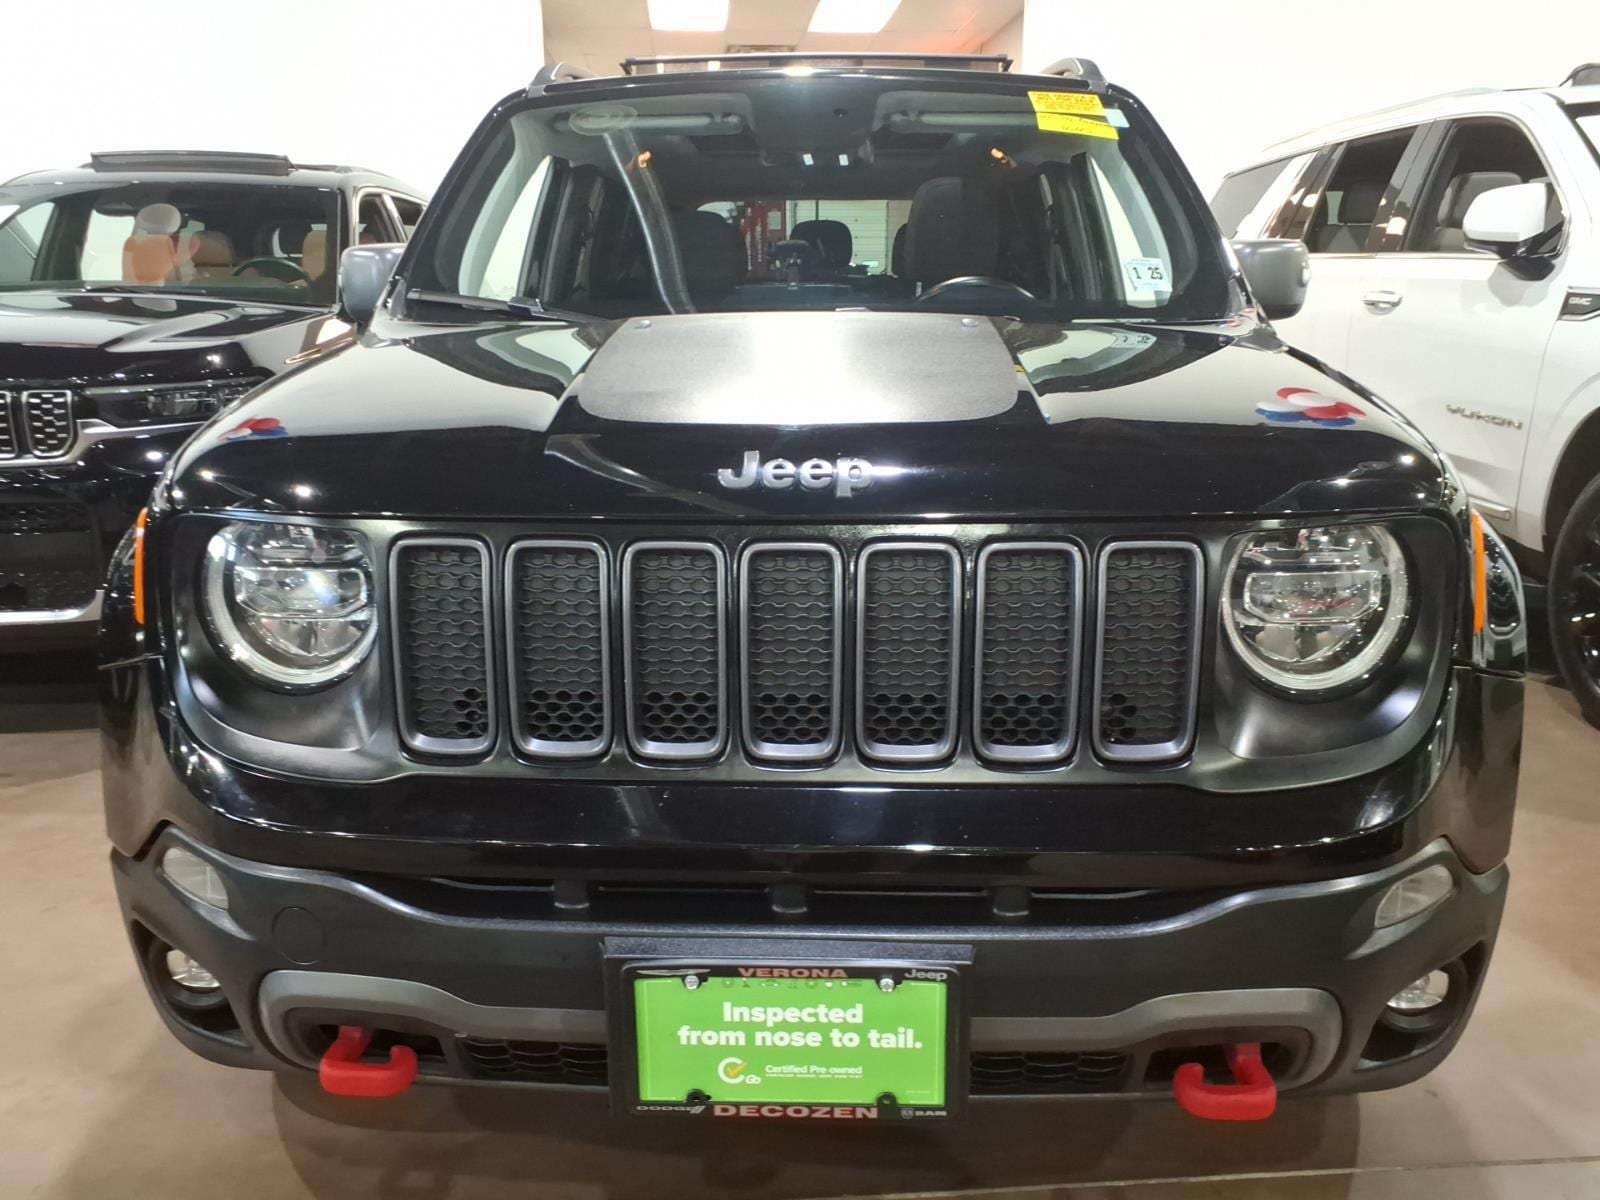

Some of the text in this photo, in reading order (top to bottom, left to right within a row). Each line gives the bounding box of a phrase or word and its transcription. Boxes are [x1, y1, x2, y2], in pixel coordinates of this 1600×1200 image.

[1147, 266, 1163, 281] 25
[1446, 403, 1523, 431] YUKON
[717, 450, 873, 498] Jeep
[738, 968, 848, 978] VERONA
[904, 969, 948, 981] Jeep
[723, 1001, 863, 1027] Inspected
[677, 1025, 923, 1049] from nose to tail.
[765, 1065, 808, 1074] Certified
[713, 1104, 878, 1119] DECOZEN
